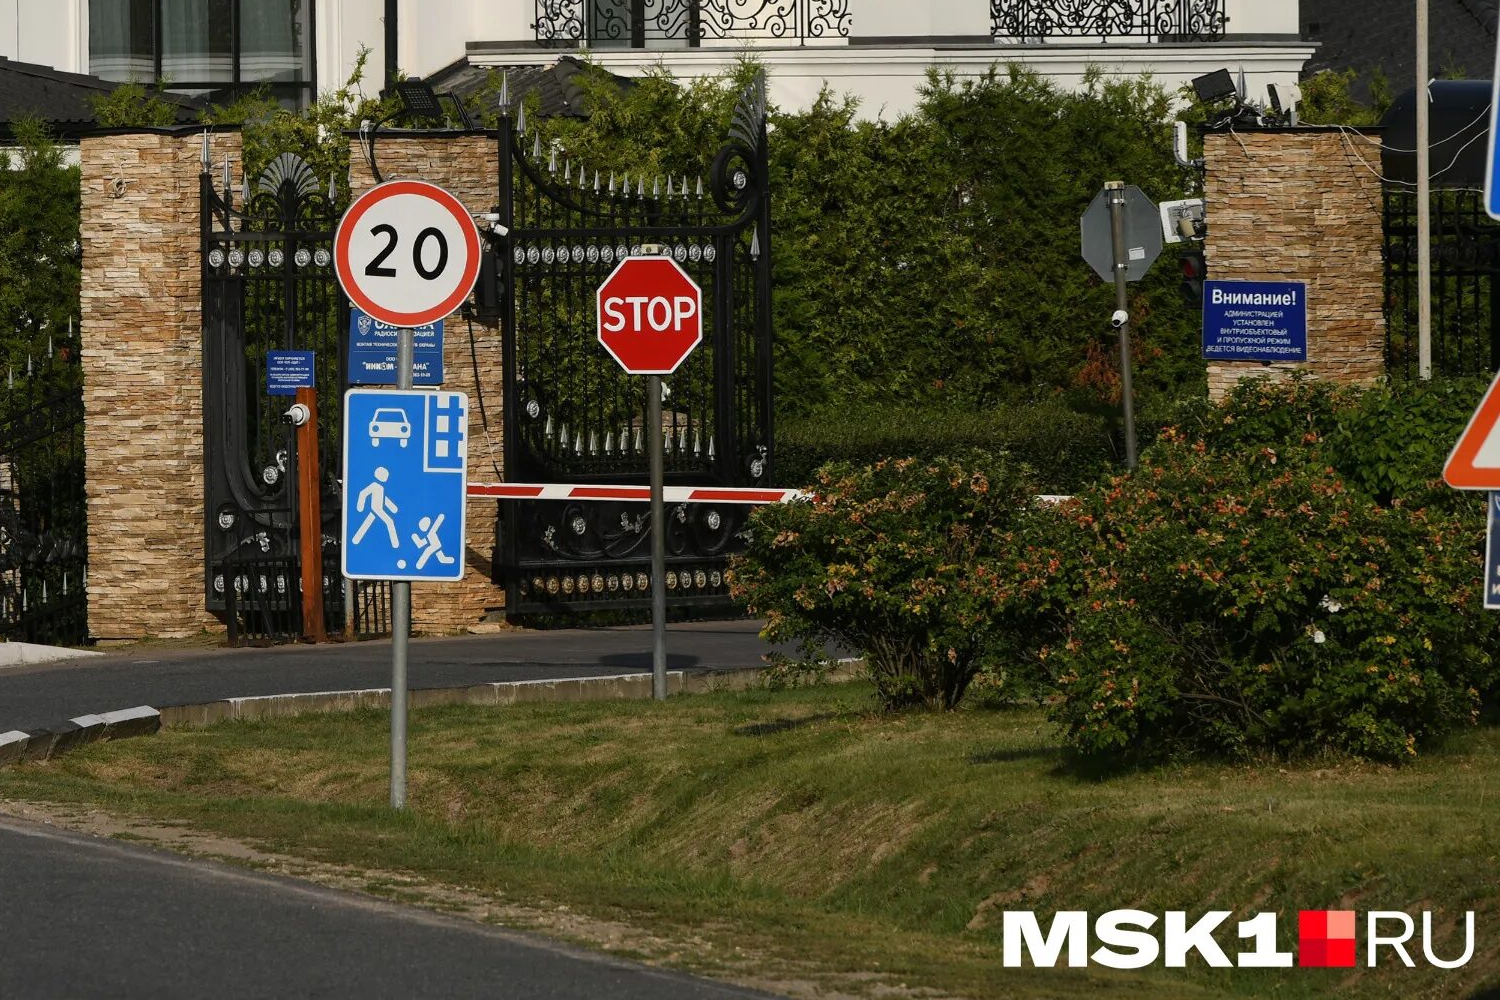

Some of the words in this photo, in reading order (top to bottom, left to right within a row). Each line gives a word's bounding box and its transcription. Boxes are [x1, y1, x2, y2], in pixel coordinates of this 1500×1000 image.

[364, 223, 448, 280] 20
[1212, 289, 1296, 305] Внимание!
[603, 296, 696, 332] STOP
[1224, 310, 1283, 318] АДМИНИСТРАЦИЕЙ
